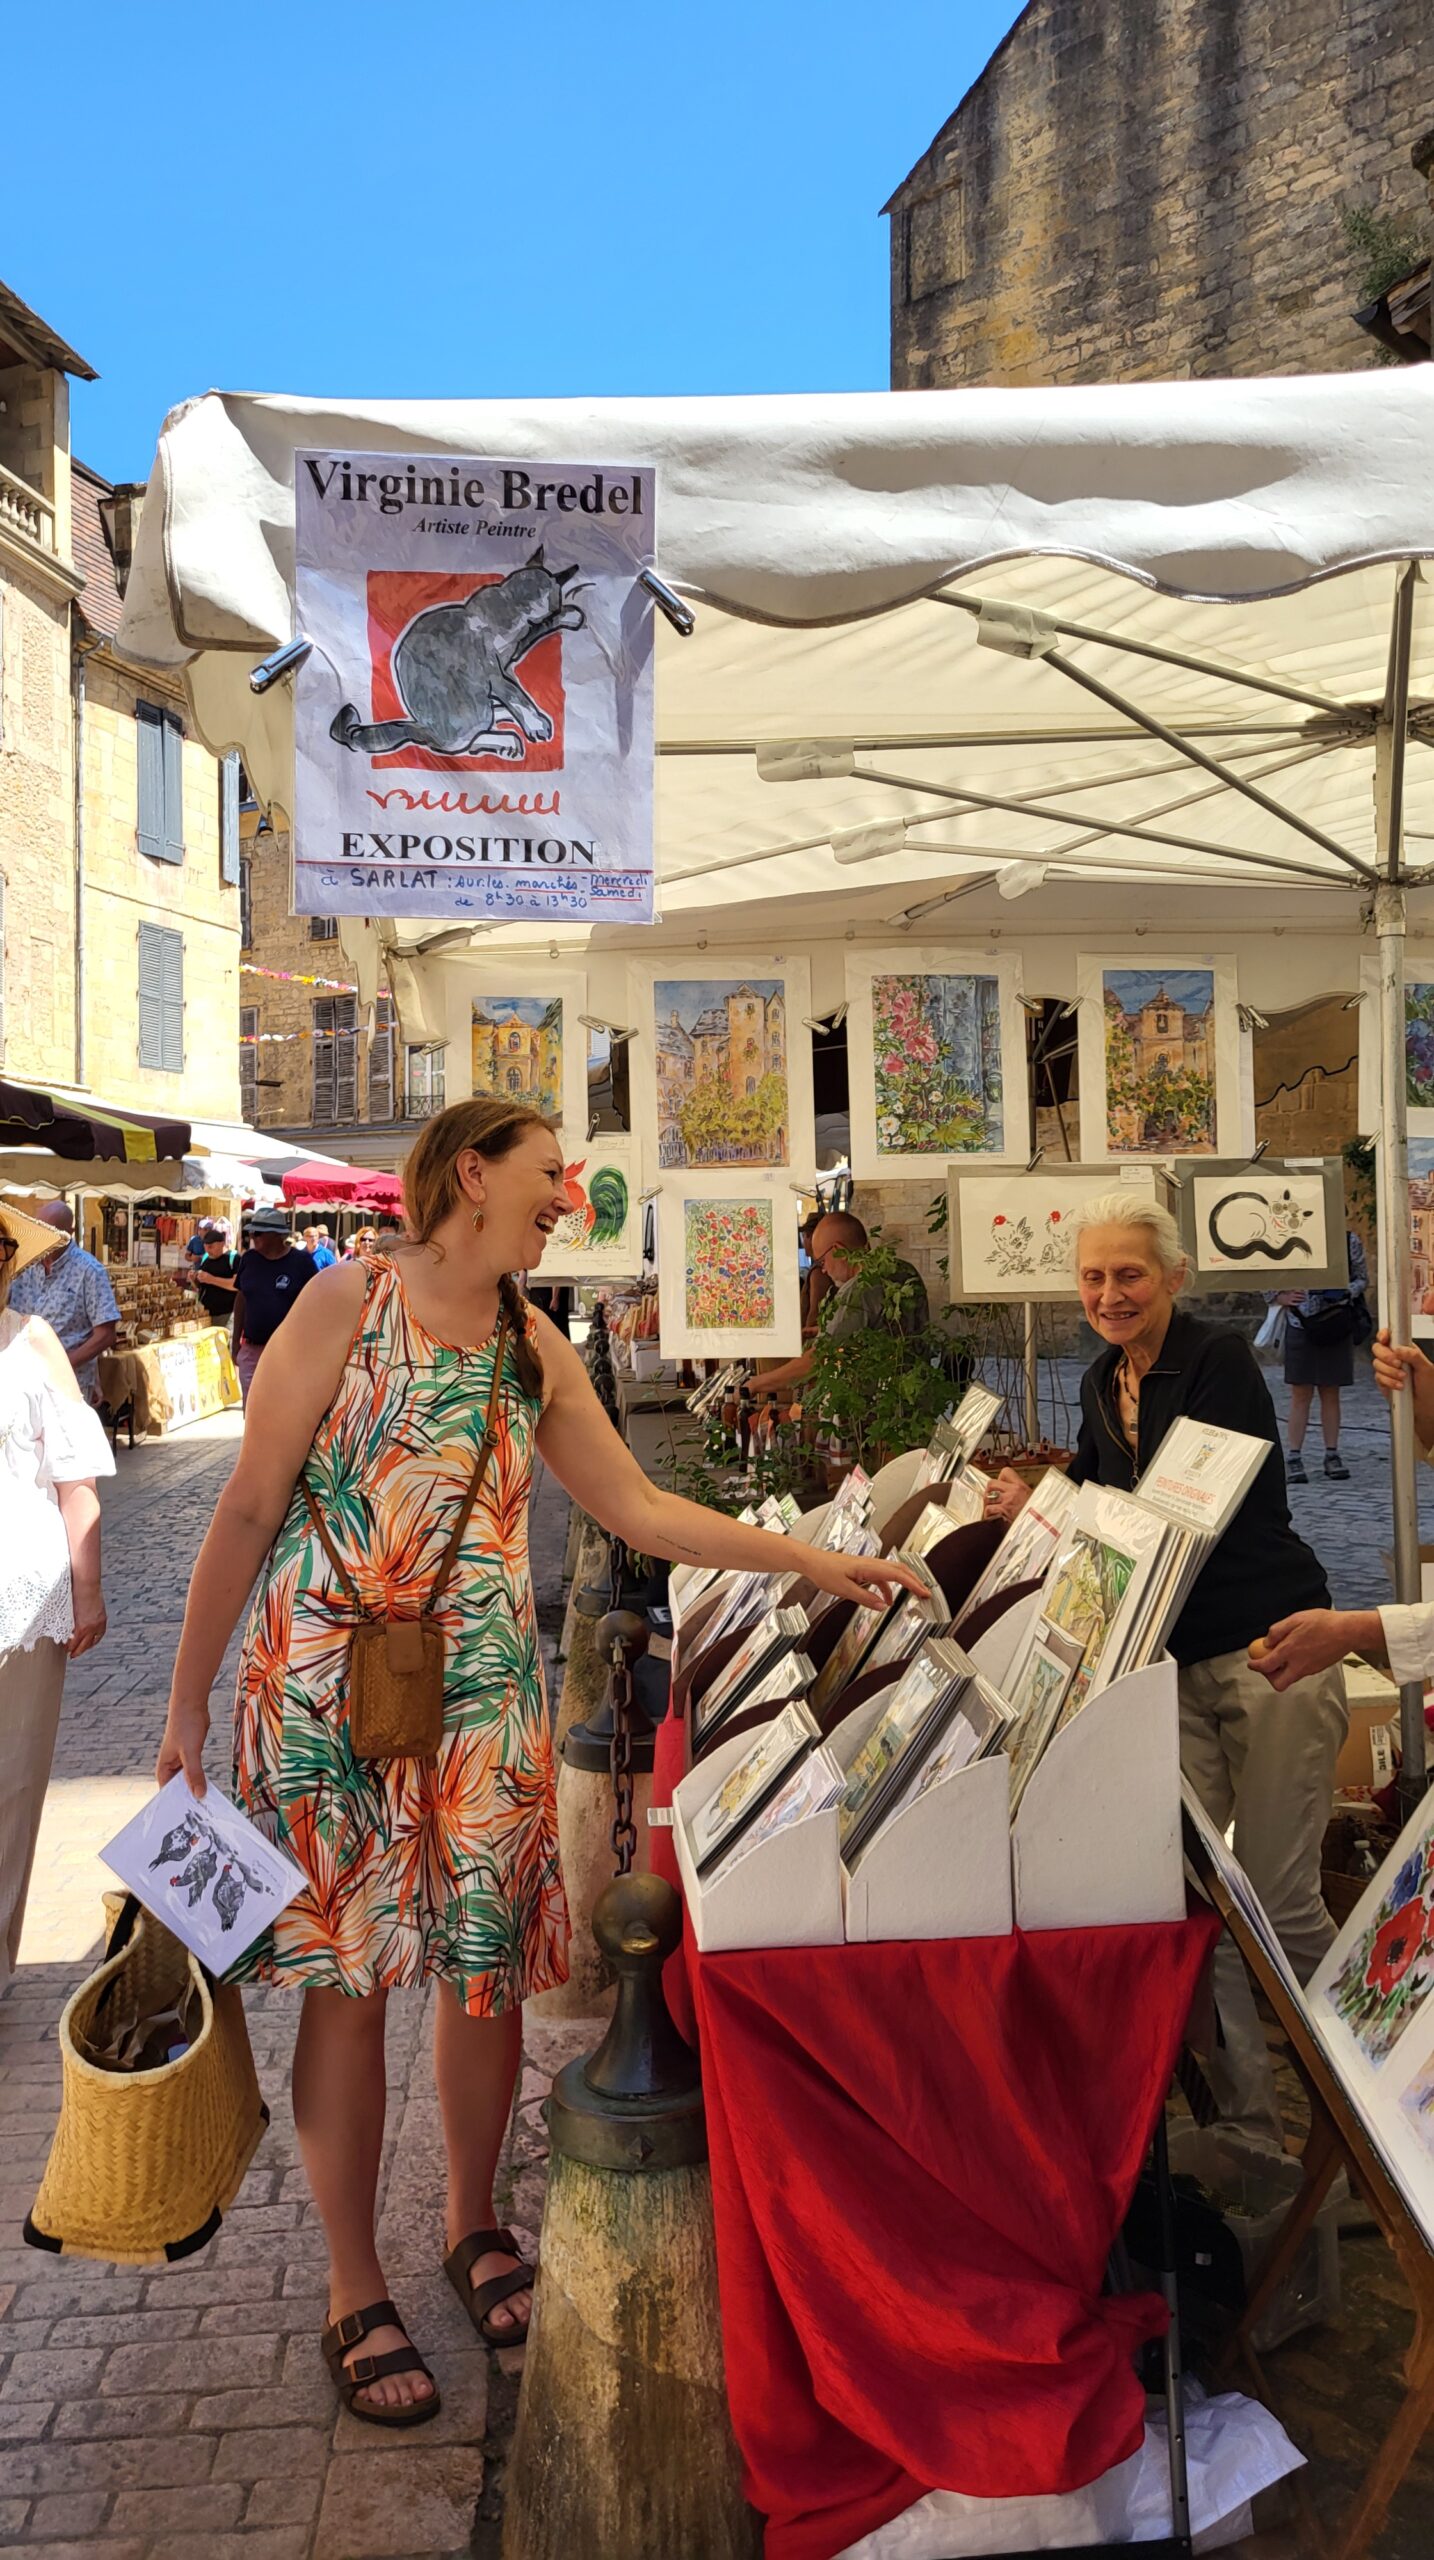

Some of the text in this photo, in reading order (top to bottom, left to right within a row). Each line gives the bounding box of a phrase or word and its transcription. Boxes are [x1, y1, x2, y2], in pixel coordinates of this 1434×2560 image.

[303, 460, 644, 515] Virginie Bredel
[412, 517, 537, 538] Artiste Peintre
[340, 833, 596, 865] EXPOSITION
[321, 869, 339, 886] à
[351, 868, 438, 888] SARLAT
[589, 885, 642, 898] Samedi
[454, 897, 475, 907] de
